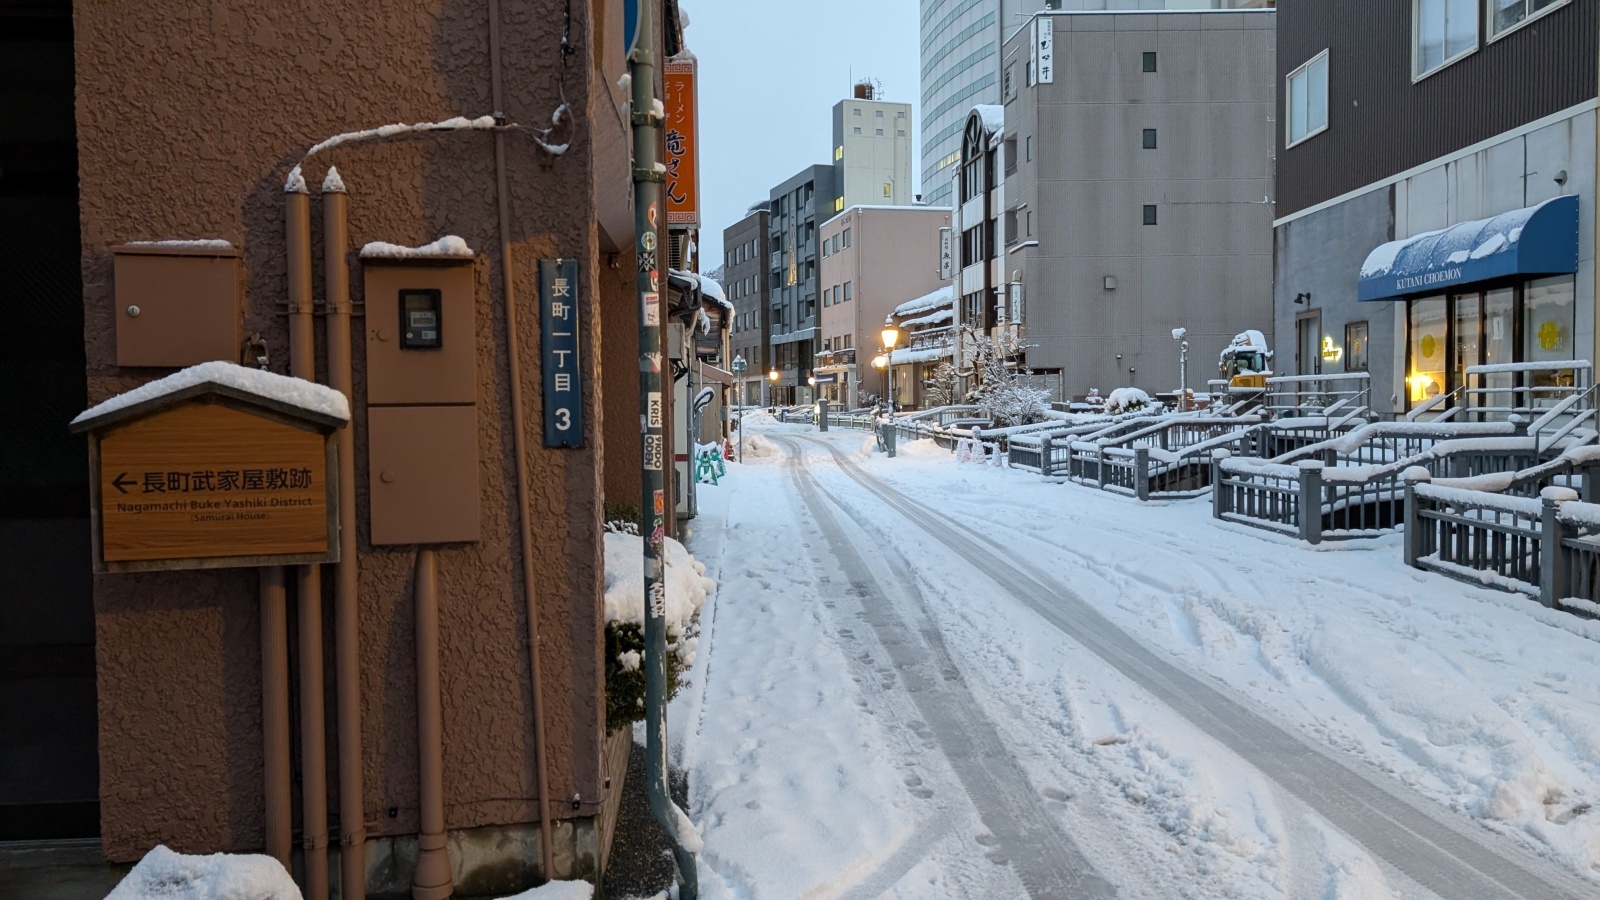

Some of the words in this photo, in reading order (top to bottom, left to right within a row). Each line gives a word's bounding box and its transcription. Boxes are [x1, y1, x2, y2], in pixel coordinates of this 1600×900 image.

[674, 81, 686, 124] ラーメン
[666, 129, 686, 205] 竜さん
[1396, 275, 1423, 290] KUTANI
[1424, 267, 1462, 285] CHOEMON
[551, 278, 572, 392] 長町一丁目
[555, 407, 572, 431] 3
[650, 400, 660, 426] KRIS
[645, 436, 655, 466] ODEN
[142, 467, 313, 494] 長町武家屋敷跡
[117, 500, 187, 515] Nagamachi
[190, 500, 221, 510] Buke
[224, 497, 267, 509] Yashiki
[270, 496, 313, 507] District
